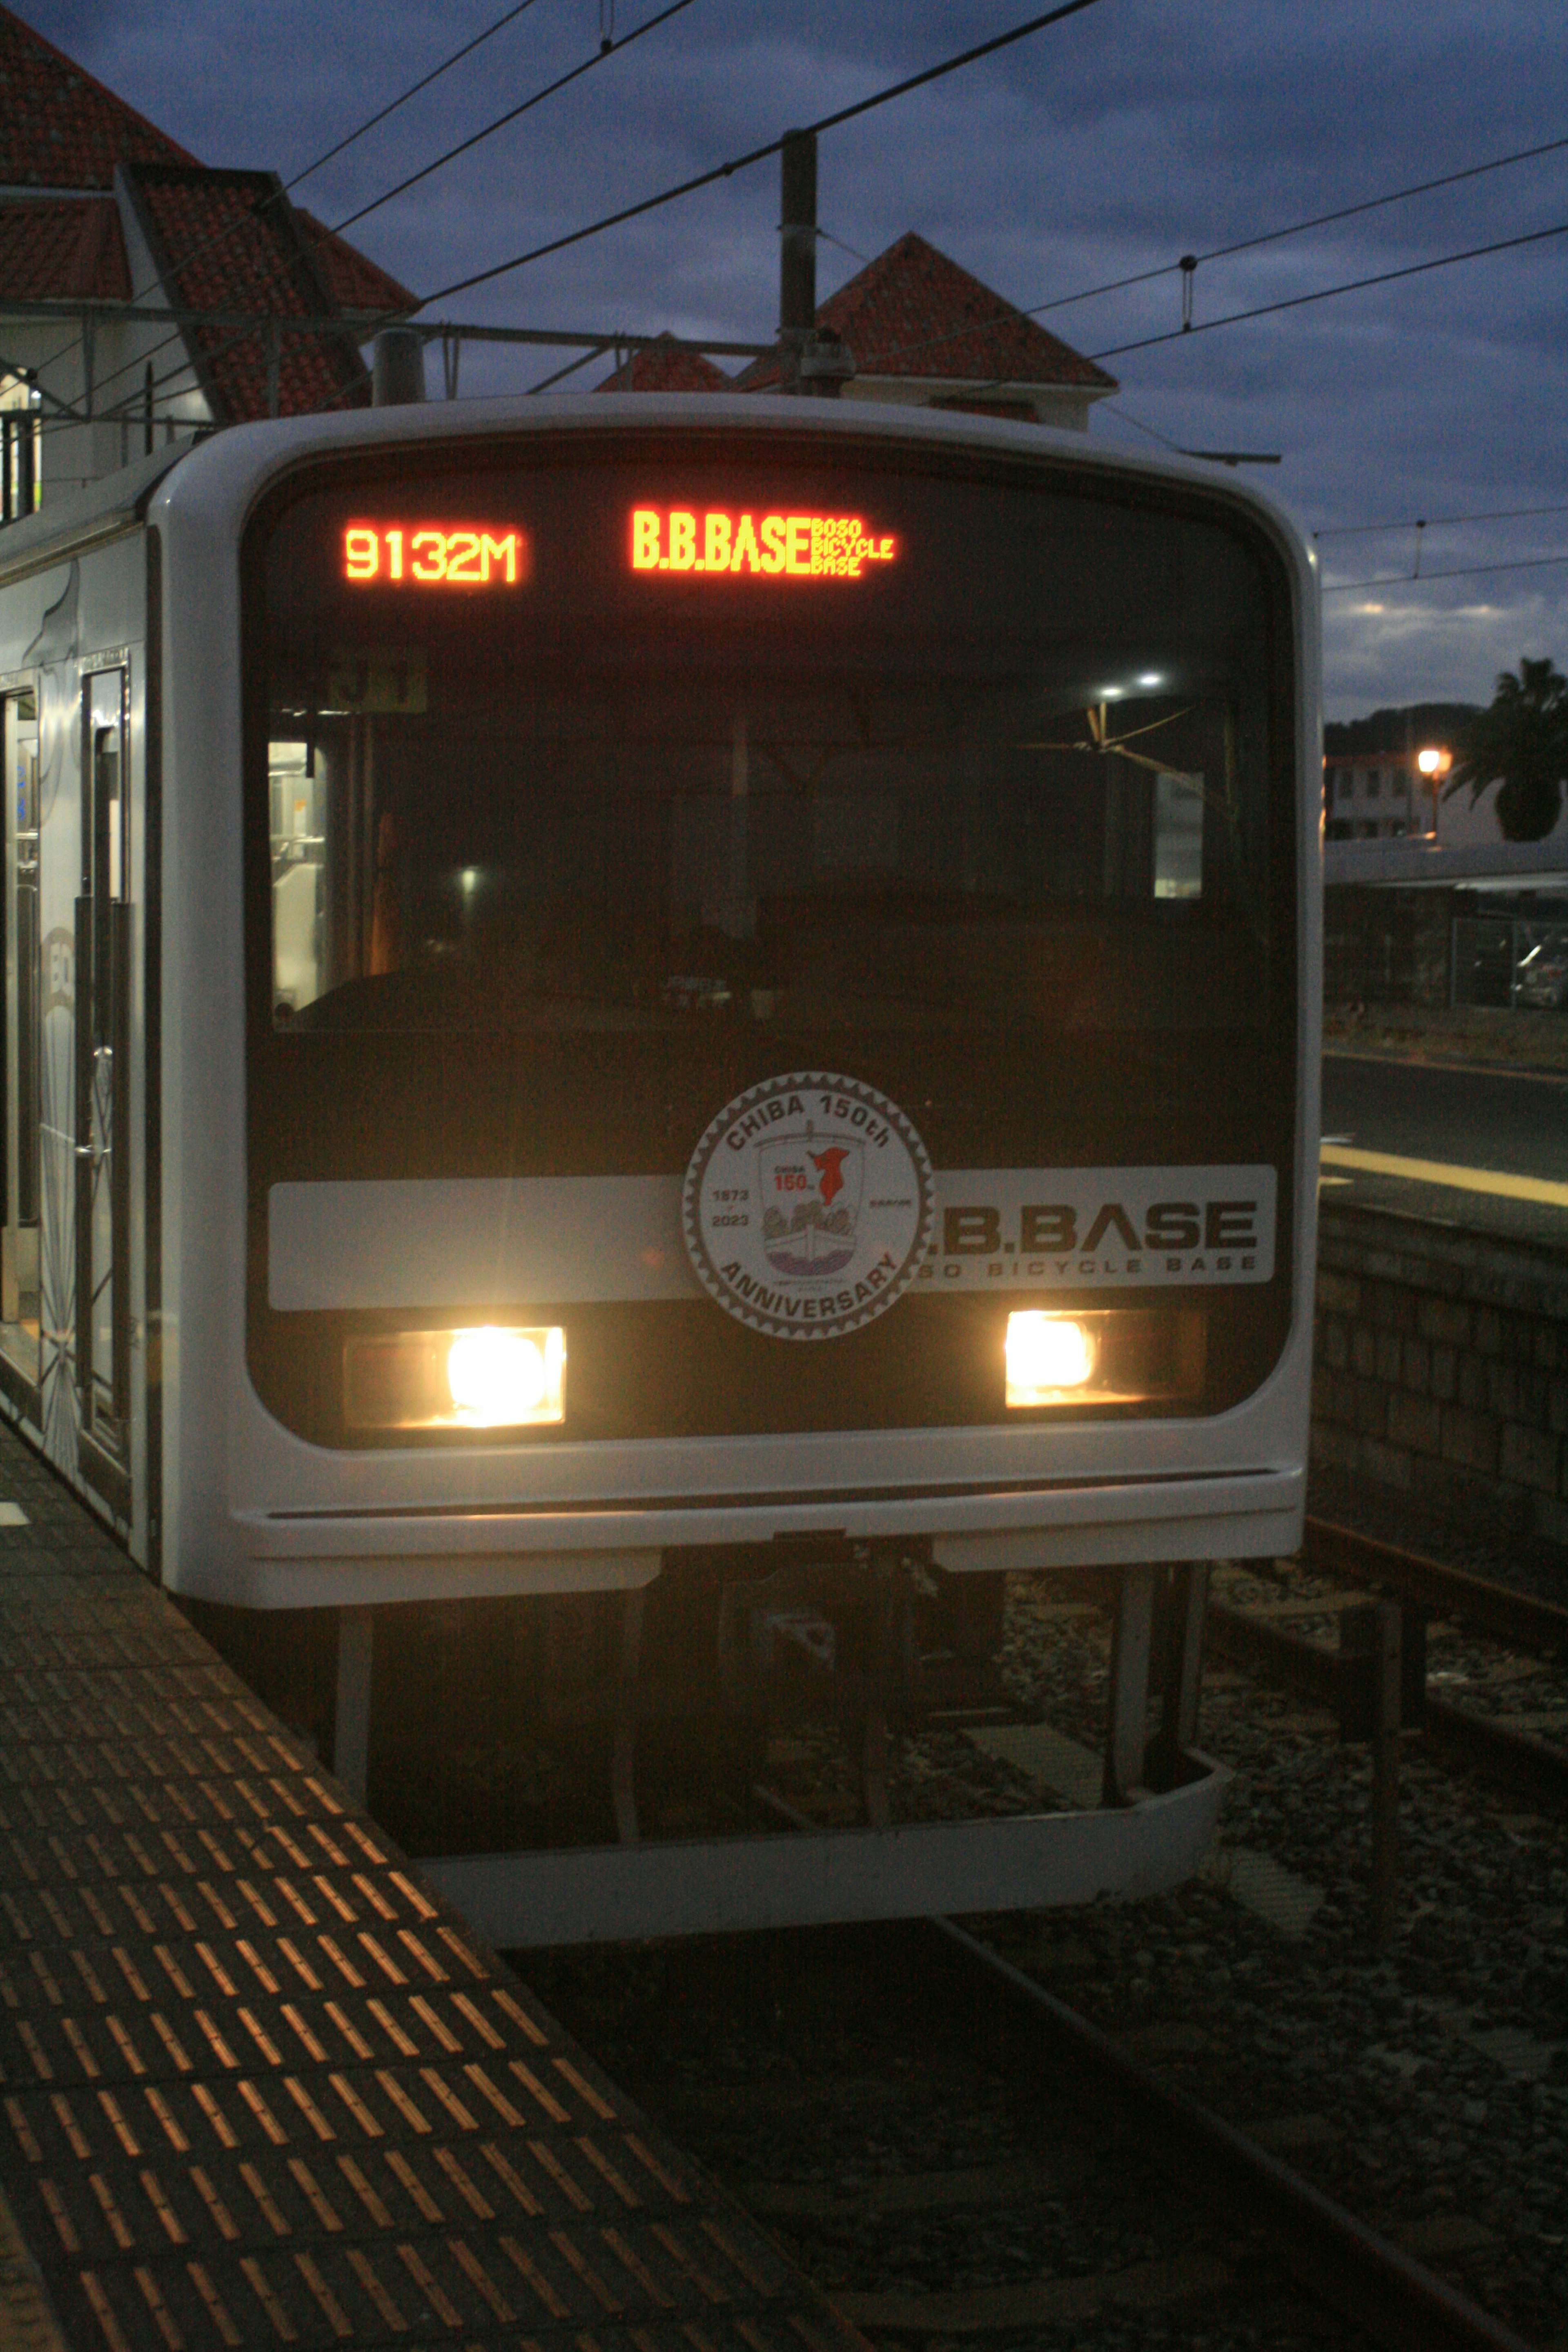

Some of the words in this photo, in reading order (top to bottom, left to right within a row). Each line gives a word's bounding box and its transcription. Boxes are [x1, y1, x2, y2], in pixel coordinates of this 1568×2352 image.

[811, 518, 861, 538] BOSO
[633, 511, 811, 574] B.B.BASE
[811, 537, 893, 559] BICYCLE
[345, 529, 516, 582] 9132M
[811, 556, 861, 576] BASE
[726, 1096, 804, 1151] CHIBA
[820, 1095, 890, 1148] 150th
[713, 1190, 749, 1201] 1873
[713, 1215, 749, 1226] 2023
[928, 1201, 1257, 1256] .B.BASE
[988, 1259, 1141, 1277] BICYCLE
[1167, 1257, 1256, 1272] BASE
[721, 1252, 897, 1318] ANNIVERSARY
